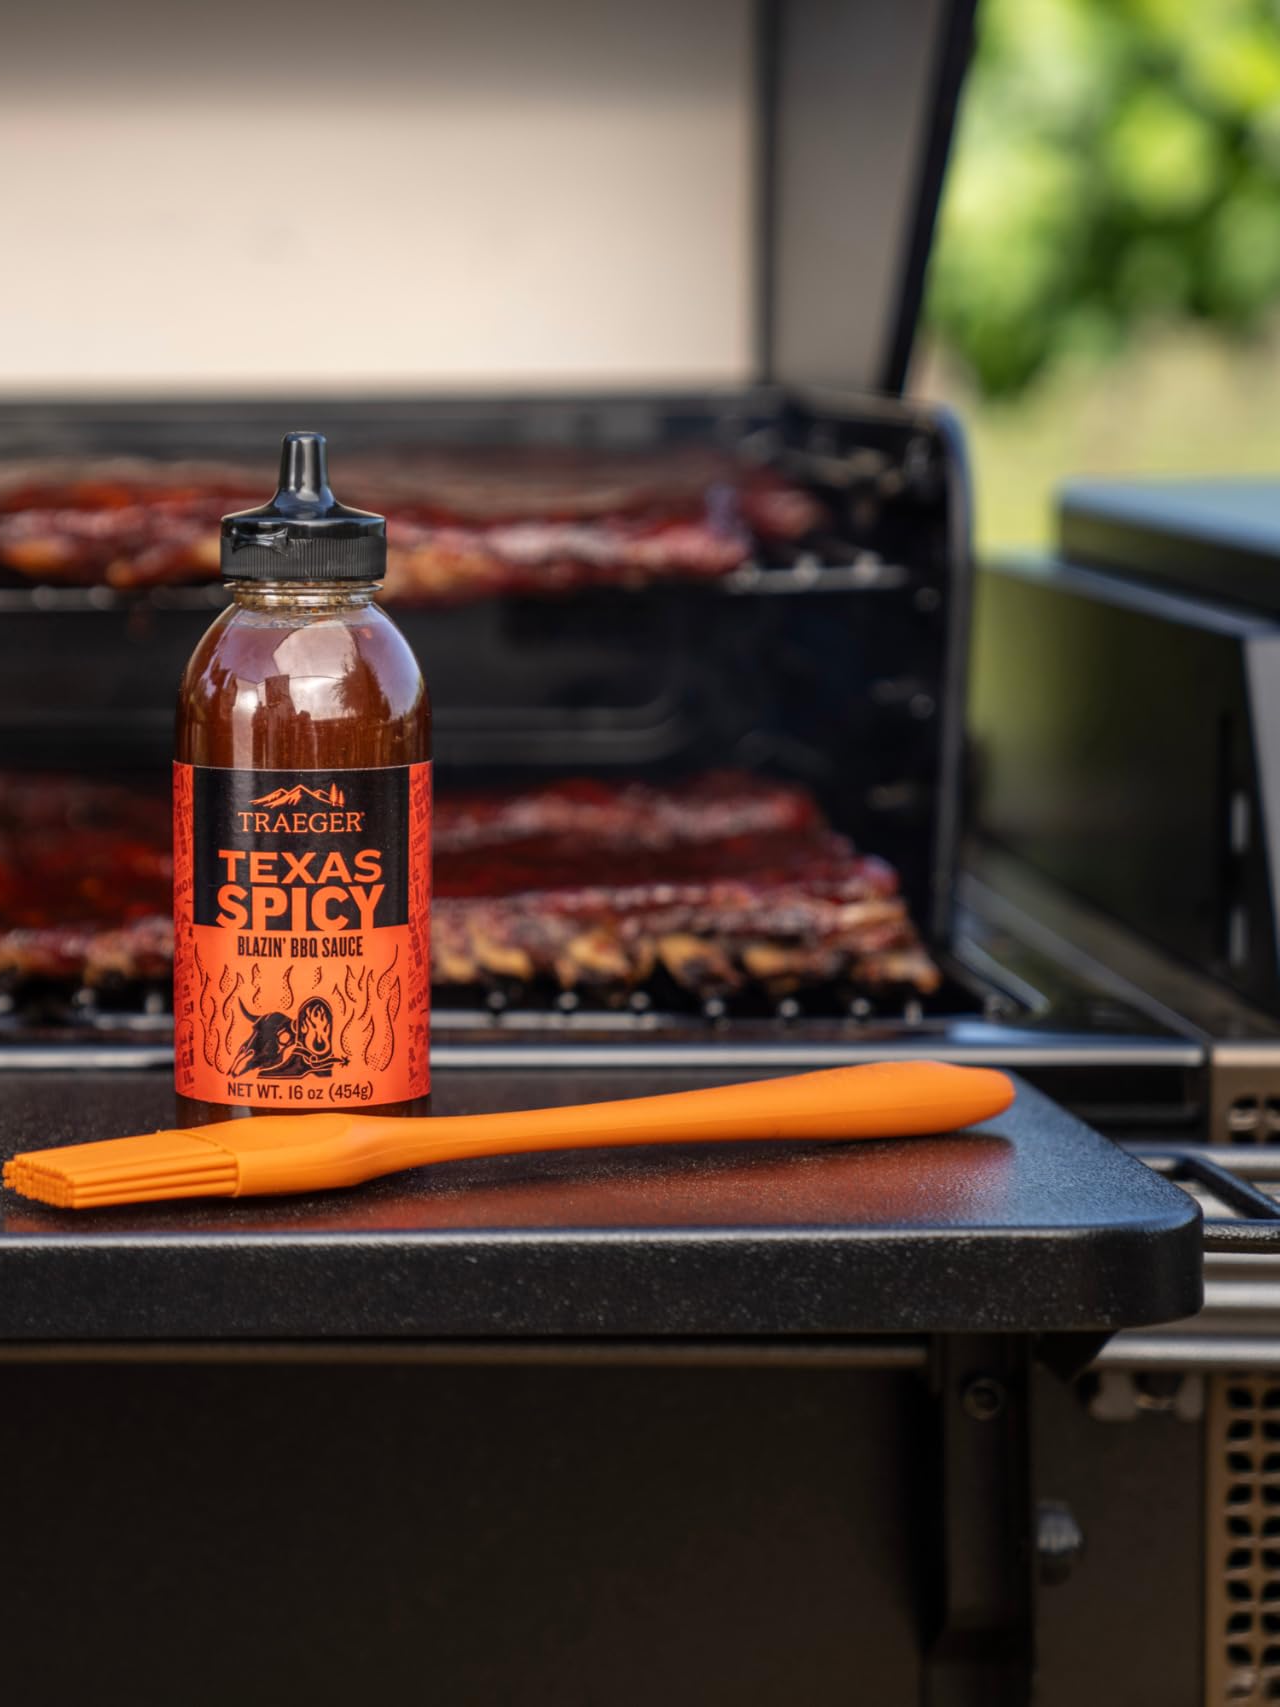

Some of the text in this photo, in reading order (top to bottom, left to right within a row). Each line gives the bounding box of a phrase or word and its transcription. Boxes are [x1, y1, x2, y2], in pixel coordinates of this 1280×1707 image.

[238, 811, 363, 833] TRAEGER
[218, 849, 383, 884] TEXAS
[216, 883, 385, 931] SPICY
[237, 936, 363, 958] BLAZIN' BBQ SAUCE
[227, 1081, 374, 1102] NET WT. 16 oz (454g)
